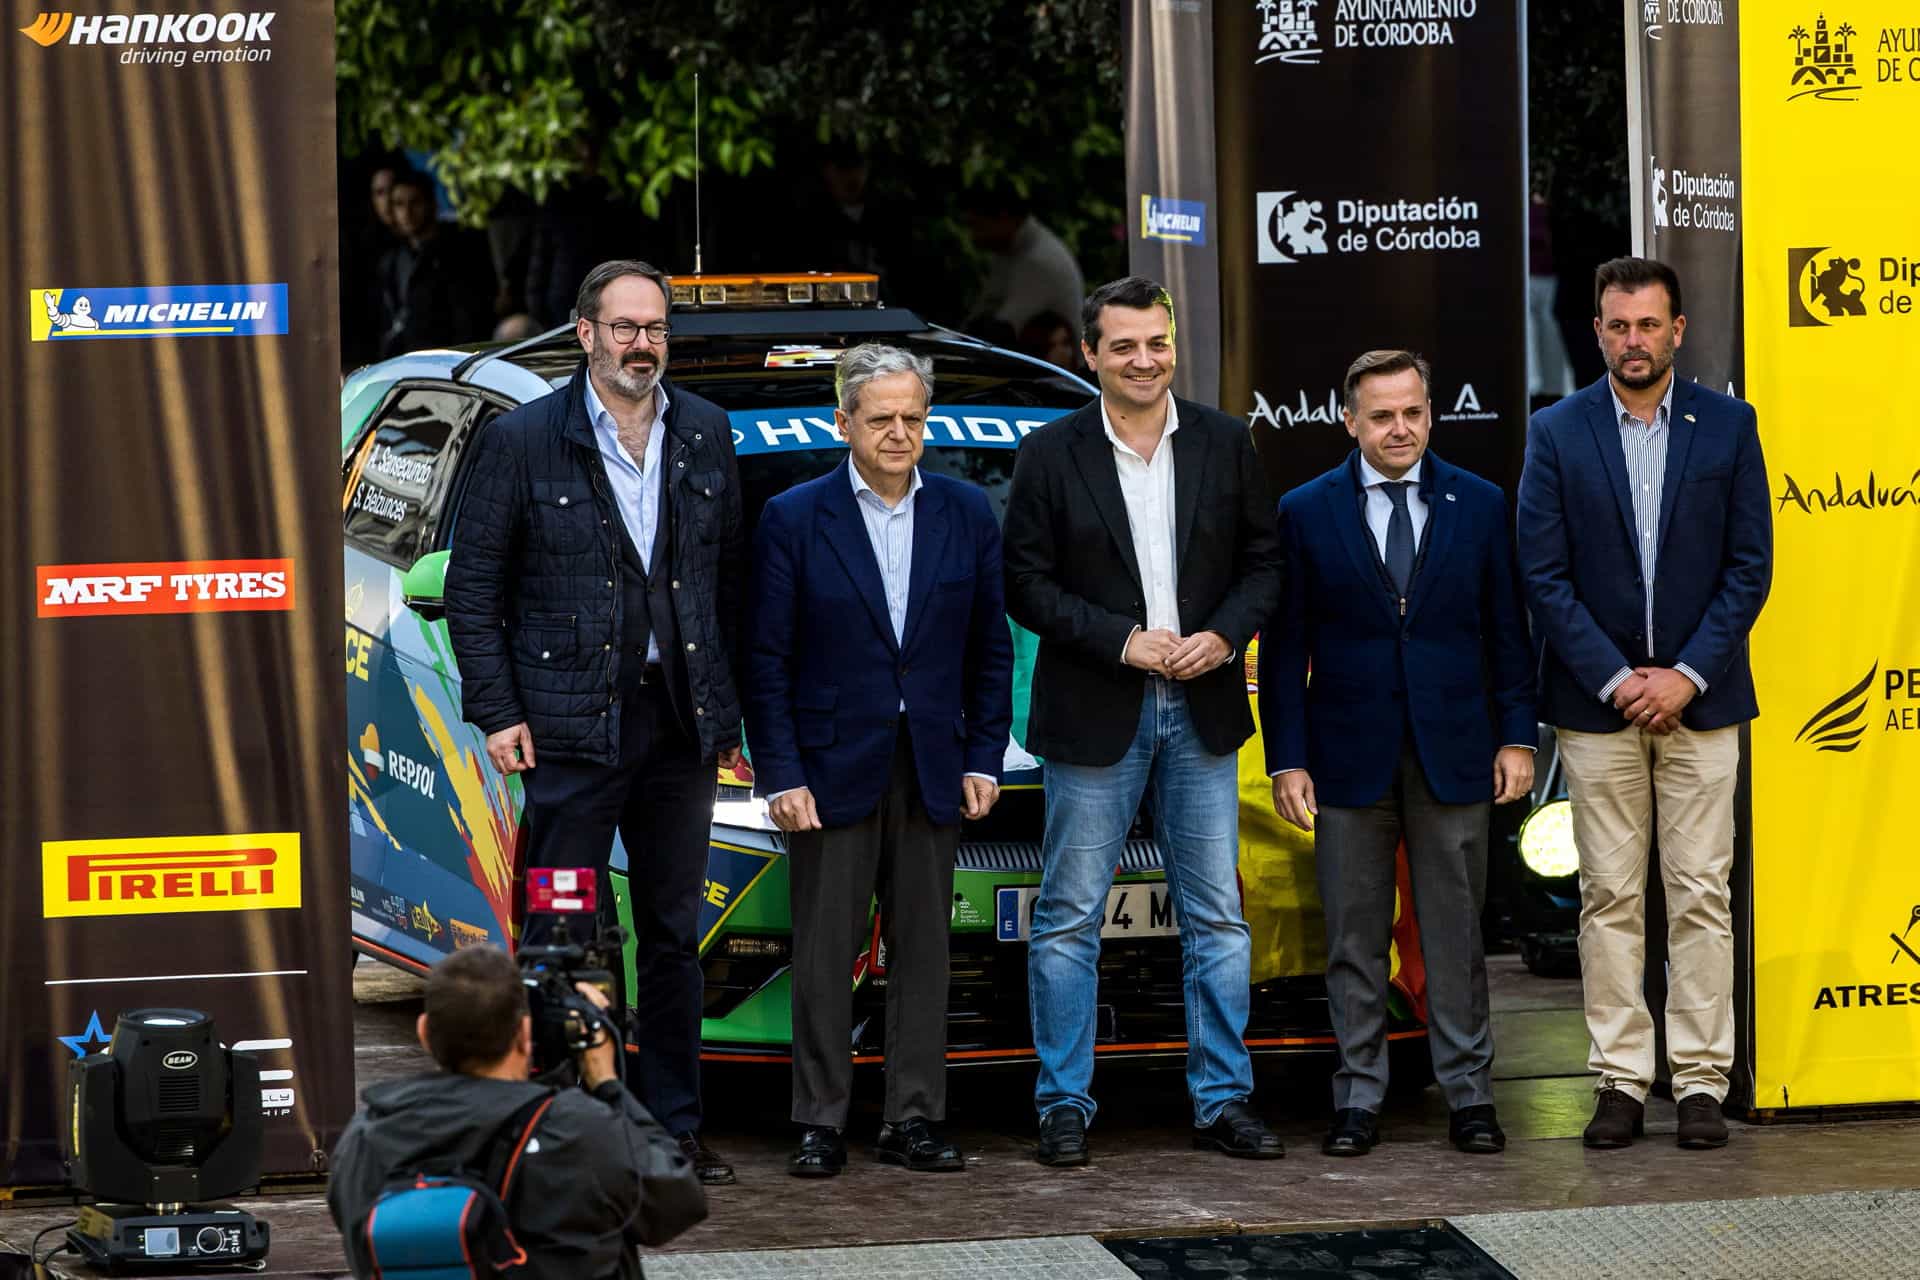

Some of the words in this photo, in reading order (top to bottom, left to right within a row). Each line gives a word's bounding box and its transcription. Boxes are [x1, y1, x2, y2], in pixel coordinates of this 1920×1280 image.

[1335, 0, 1477, 21] AYUNTAMIENTO
[1668, 0, 1680, 23] DE
[1335, 24, 1358, 47] DE
[1362, 17, 1454, 46] CÓRDOBA
[1877, 28, 1920, 52] AYU
[120, 47, 185, 67] driving
[192, 47, 271, 63] emotion
[1877, 58, 1902, 82] DE
[1672, 170, 1735, 202] Diputación
[1338, 196, 1478, 229] Diputación
[1673, 201, 1690, 227] de
[1693, 202, 1735, 232] Córdoba
[1337, 228, 1368, 252] de
[1376, 225, 1480, 250] Córdoba
[103, 301, 267, 324] MICHELIN
[1879, 288, 1913, 315] de
[44, 575, 163, 606] MRF
[170, 571, 287, 601] TYRES
[1885, 707, 1920, 732] AE
[388, 749, 436, 800] REPSOL
[67, 847, 278, 902] PIRELLI
